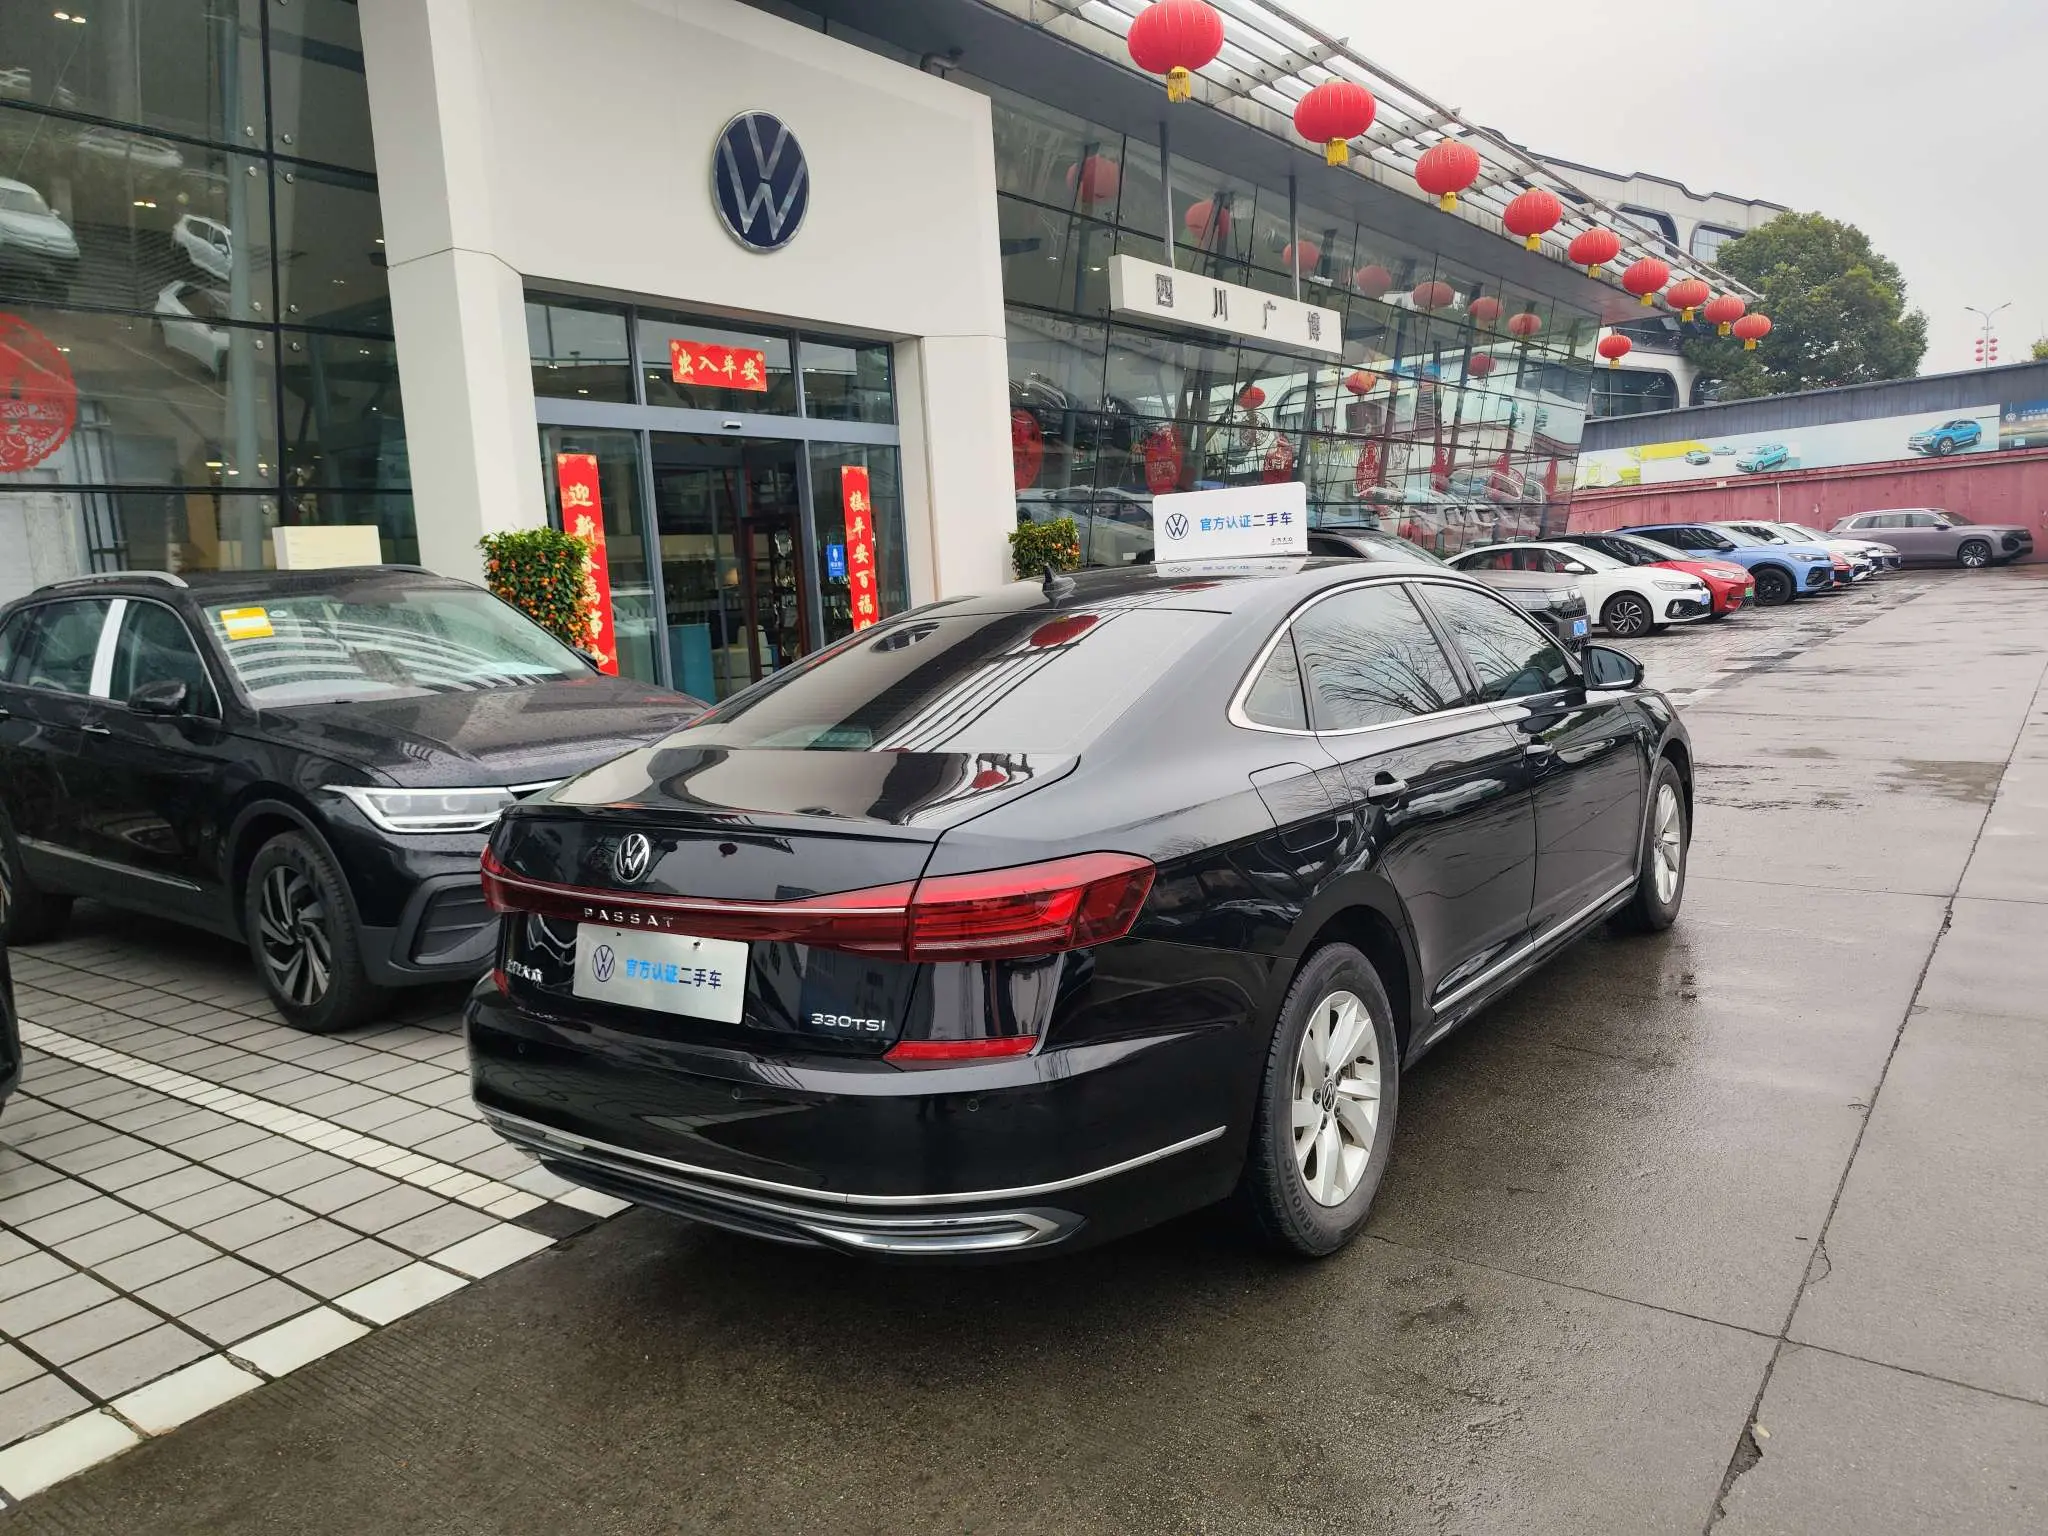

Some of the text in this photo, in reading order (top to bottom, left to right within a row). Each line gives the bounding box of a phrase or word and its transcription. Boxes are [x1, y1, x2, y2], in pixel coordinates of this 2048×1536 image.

[678, 348, 761, 383] 出入平安
[1200, 511, 1294, 532] 官方认证二手车
[583, 907, 675, 928] PASSAT
[626, 958, 722, 990] 官方认证二手车
[811, 1012, 886, 1032] 330TSI
